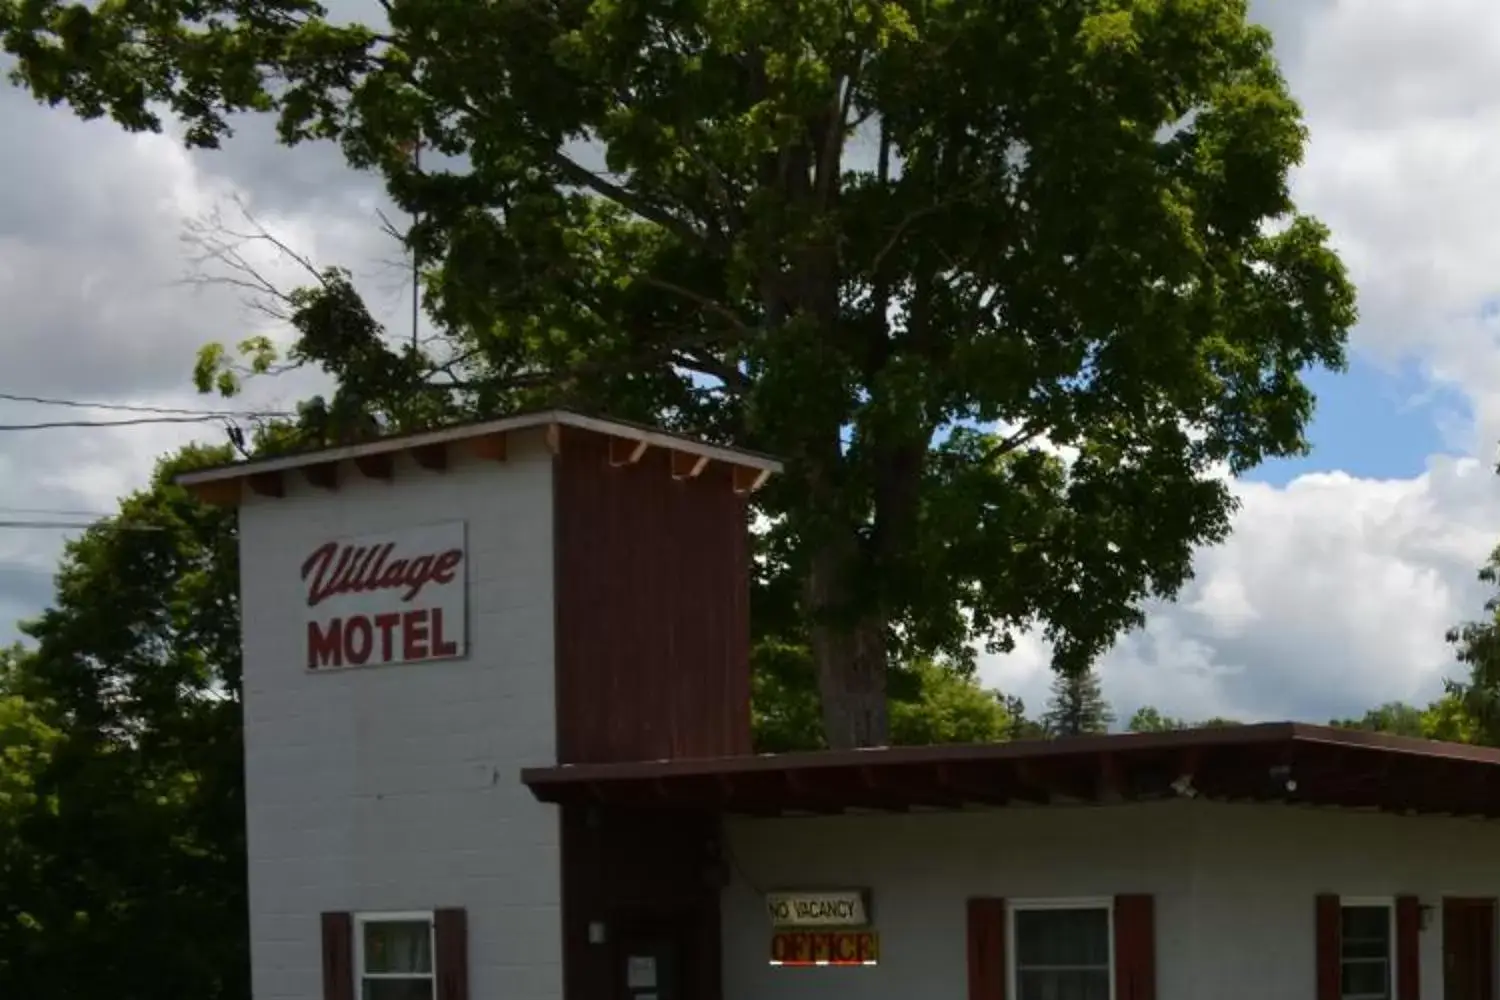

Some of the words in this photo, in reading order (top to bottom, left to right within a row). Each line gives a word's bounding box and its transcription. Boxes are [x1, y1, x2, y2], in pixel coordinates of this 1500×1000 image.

[301, 541, 462, 606] Village
[308, 608, 457, 668] MOTEL
[769, 901, 789, 918] NO
[793, 900, 854, 918] VACANCY
